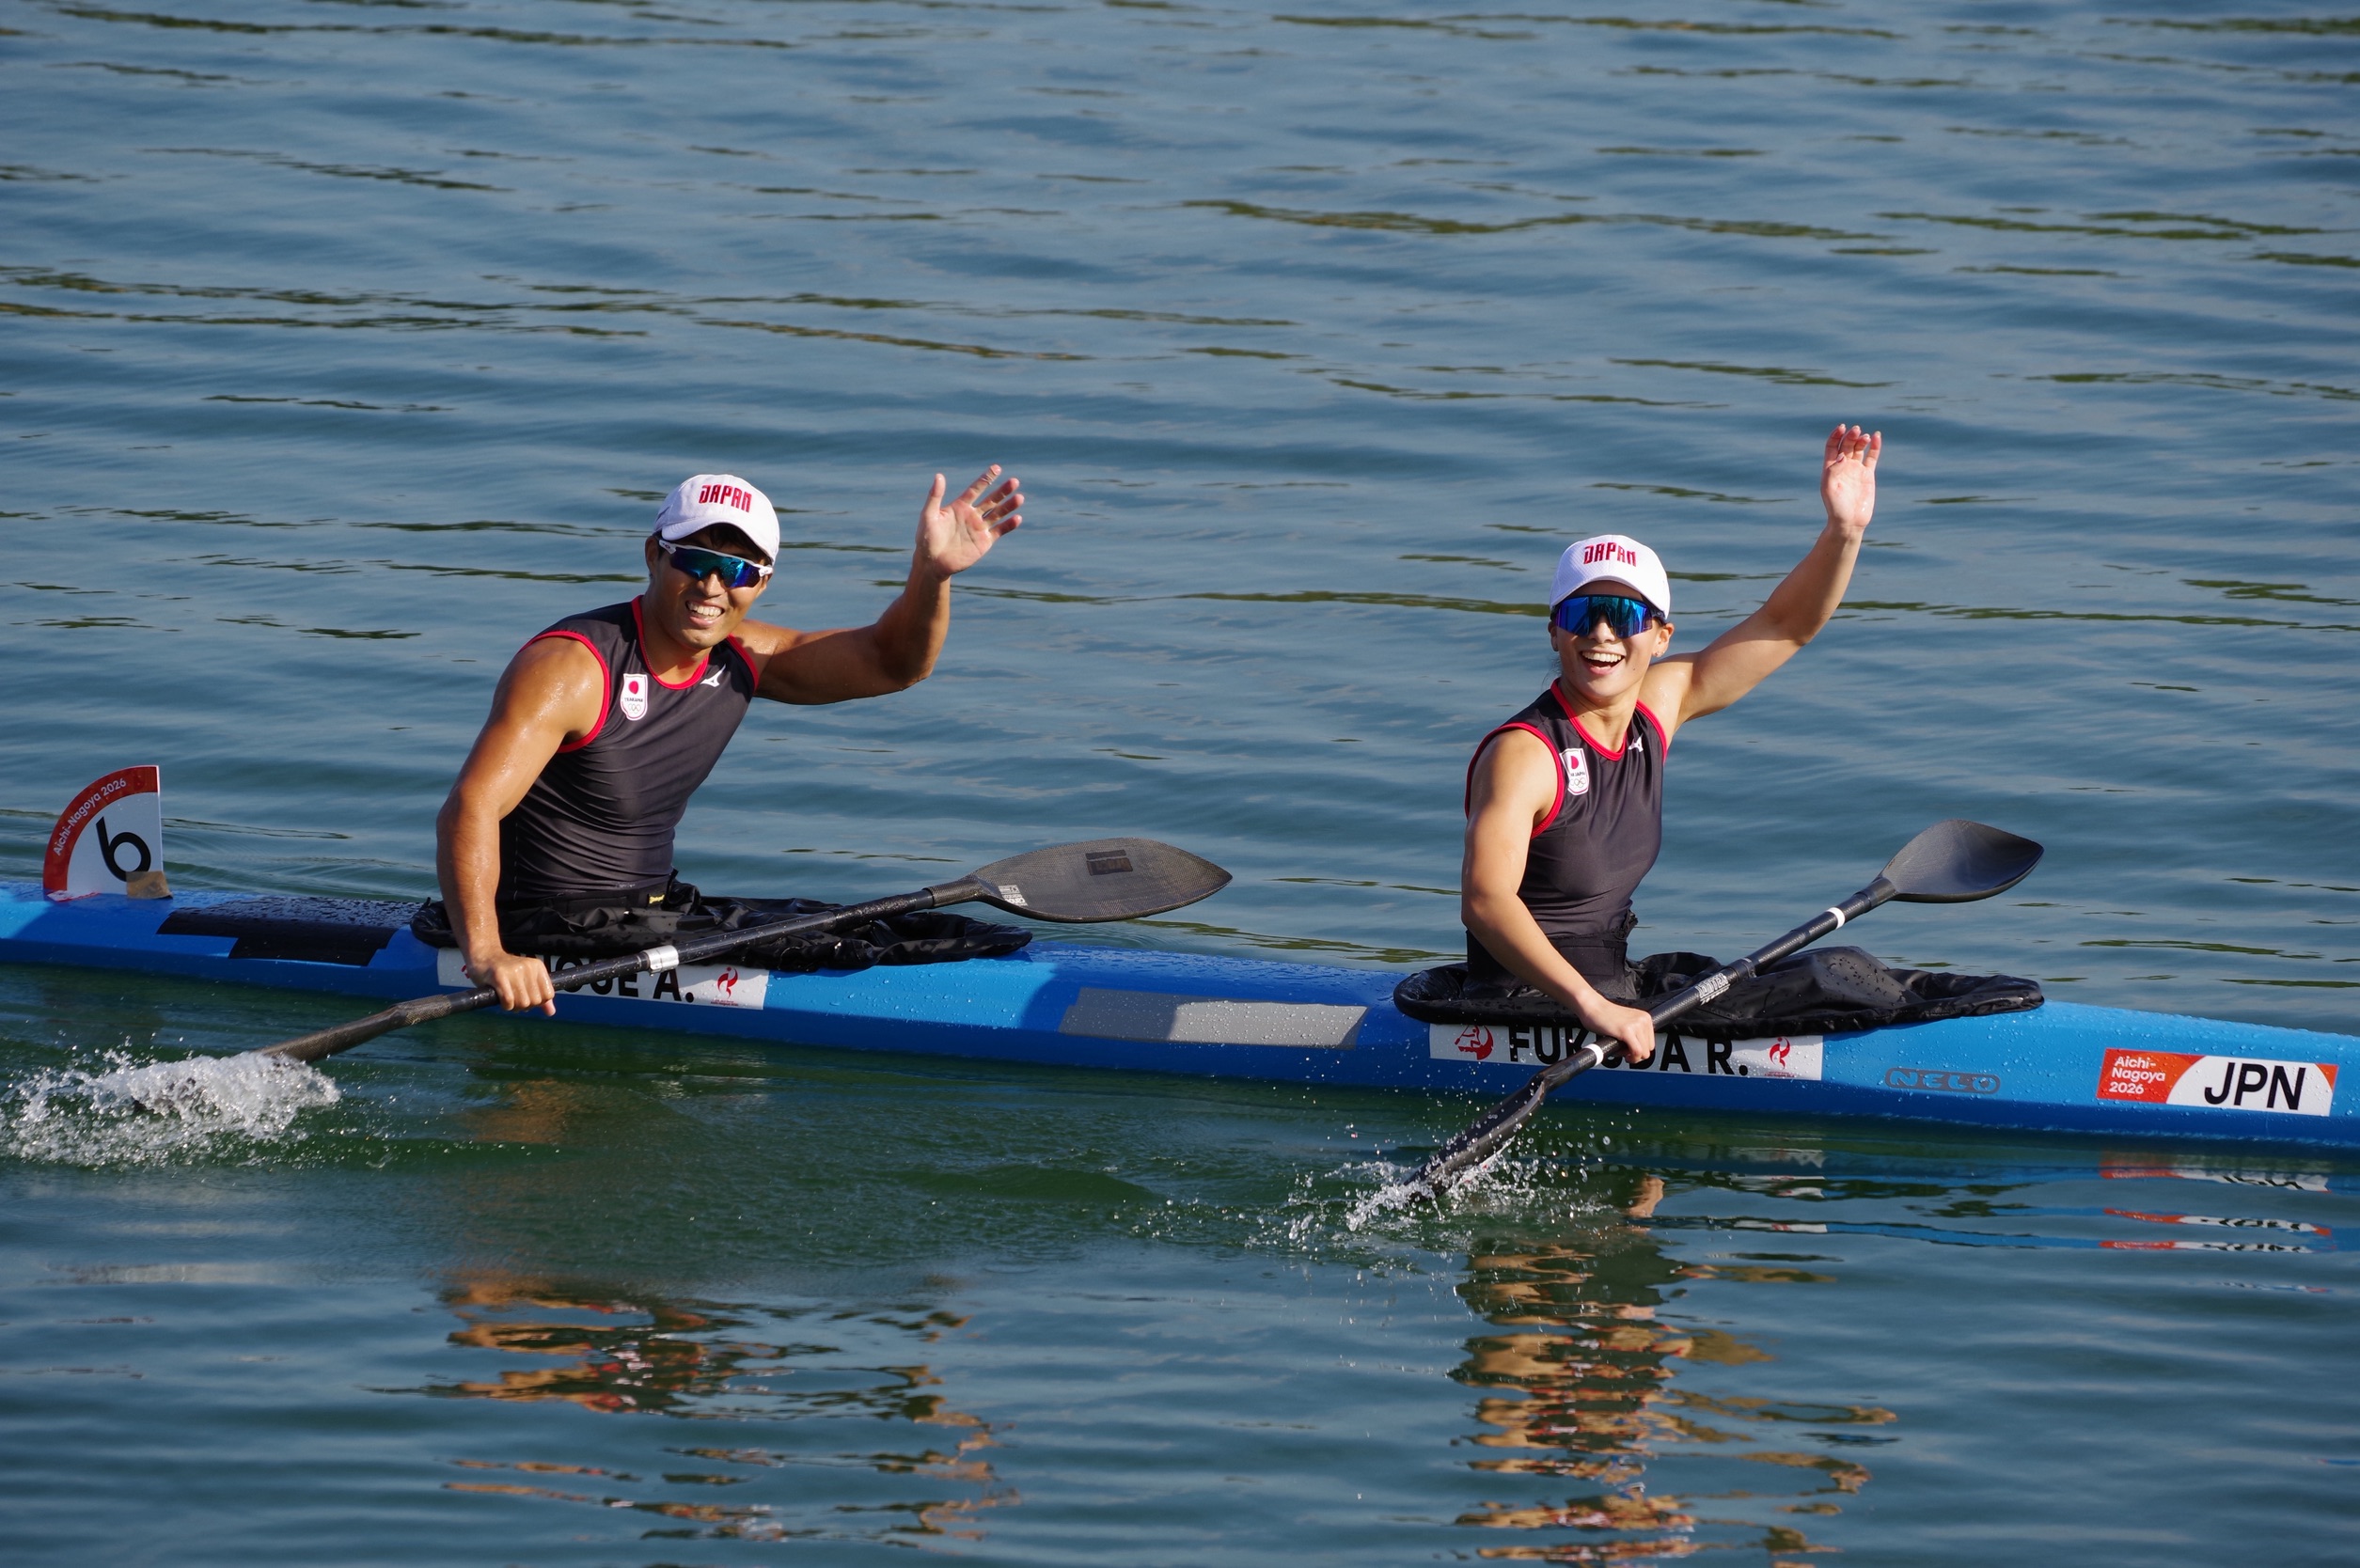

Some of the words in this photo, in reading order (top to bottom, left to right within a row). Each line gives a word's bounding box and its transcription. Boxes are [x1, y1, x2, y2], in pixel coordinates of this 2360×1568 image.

[699, 484, 752, 512] JAPAN
[1583, 542, 1637, 567] JAPAN
[53, 792, 102, 856] Aichi-Nagoya
[101, 778, 127, 796] 2026
[96, 816, 151, 882] 6
[1508, 1026, 1691, 1073] FUKA
[1707, 1037, 1749, 1076] R.
[2114, 1055, 2157, 1070] Aichi-
[1889, 1070, 1997, 1093] NELO
[2108, 1081, 2145, 1095] 2026
[2111, 1066, 2166, 1084] Nagoya
[2204, 1061, 2306, 1111] JPN
